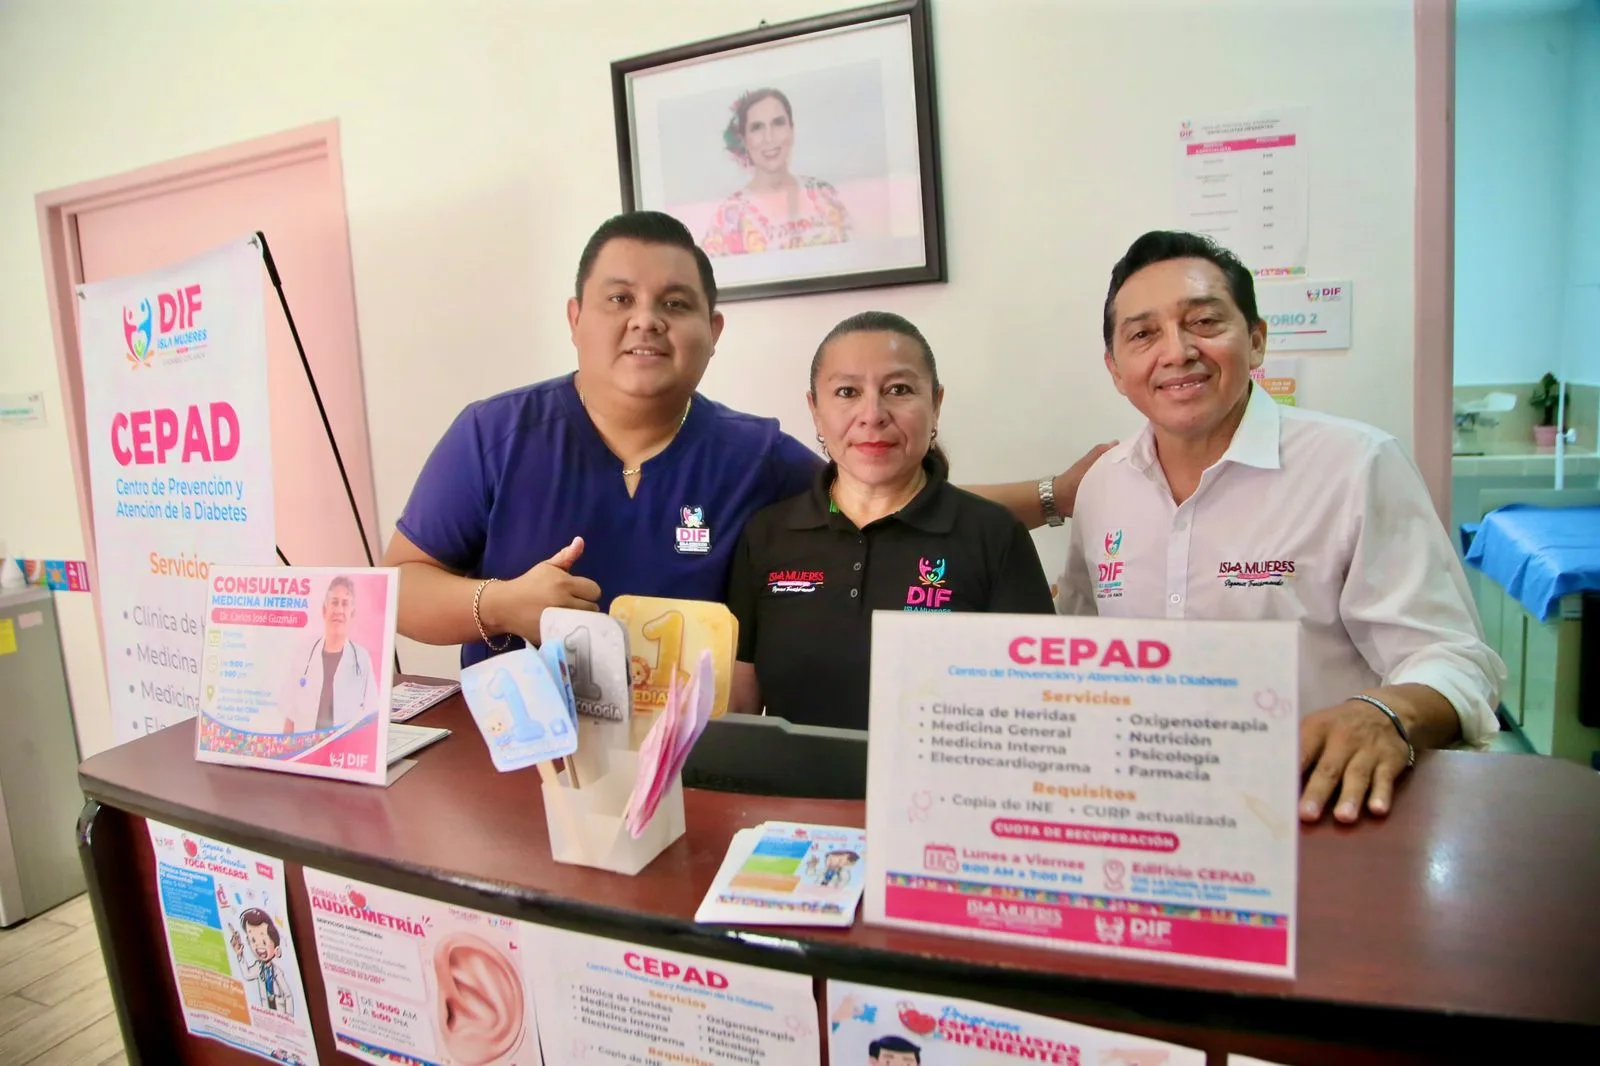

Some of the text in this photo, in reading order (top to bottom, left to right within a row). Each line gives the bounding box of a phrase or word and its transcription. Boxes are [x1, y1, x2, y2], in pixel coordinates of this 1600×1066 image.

[1322, 287, 1341, 297] DIF
[157, 284, 202, 334] DIF
[1309, 313, 1318, 325] 2
[111, 401, 240, 467] CEPAD
[116, 474, 244, 501] Centro de Prevención y
[116, 499, 247, 522] Atención de la Diabetes
[679, 528, 707, 541] DIF
[150, 552, 210, 580] Servicio
[769, 569, 824, 581] ISLA MUJERES
[1098, 561, 1124, 581] DIF
[1219, 560, 1296, 574] ISLA MUJERES
[213, 576, 311, 596] CONSULTAS
[906, 585, 952, 608] DIF
[212, 595, 309, 609] MEDICINA INTERNA
[133, 605, 197, 636] Clínica de
[268, 613, 298, 625] Guzmán
[137, 643, 198, 674] Medicina
[642, 610, 691, 688] 1
[1008, 636, 1172, 670] CEPAD
[563, 625, 602, 701] 1
[948, 664, 1239, 688] Centro de Prevención y Atención de la Diabetes
[486, 666, 545, 742] 1
[1042, 689, 1132, 706] Servicios
[932, 702, 1077, 723] Clínica de Heridas
[931, 720, 1072, 739] Medicina General
[1129, 714, 1269, 734] Oxigenoterapia
[931, 736, 1067, 756] Medicina Interna
[1129, 731, 1212, 747] Nutrición
[346, 752, 369, 768] DIF
[930, 751, 1092, 774] Electrocardiograma
[1129, 747, 1220, 766] Psicología
[1129, 765, 1211, 782] Farmacia
[1032, 780, 1138, 802] Requisitos
[952, 793, 1054, 814] Copia de INE
[1082, 804, 1238, 829] CURP actualizada
[995, 822, 1175, 848] CUOTA DE RECUPERACIÓN
[184, 857, 206, 869] TOCA
[208, 863, 249, 880] CHECARSE
[962, 848, 1086, 870] Lunes a Viernes
[993, 866, 1015, 877] AM
[1060, 873, 1084, 884] PM
[1131, 862, 1256, 885] Edificio CEPAD
[312, 896, 426, 938] AUDIOMETRÍA
[1129, 919, 1172, 938] DIF
[623, 952, 729, 990] CEPAD
[338, 990, 354, 1008] 25
[376, 1000, 400, 1015] 10:00
[579, 984, 674, 1013] Clínica de Heridas
[580, 995, 671, 1022] Medicina General
[648, 989, 708, 1009] Servicios
[580, 1005, 669, 1033] Medicina Interna
[706, 1014, 796, 1043] Oxigenoterapia
[941, 1005, 1022, 1030] Programa
[581, 1016, 686, 1048] Electrocardiograma
[707, 1025, 760, 1046] Nutrición
[938, 1018, 1081, 1054] ESPECIALISTAS
[598, 1045, 627, 1062] Copia
[629, 1052, 643, 1064] de
[708, 1036, 767, 1058] Psicología
[708, 1046, 761, 1066] Farmacia
[945, 1029, 1080, 1066] DIFERENTES
